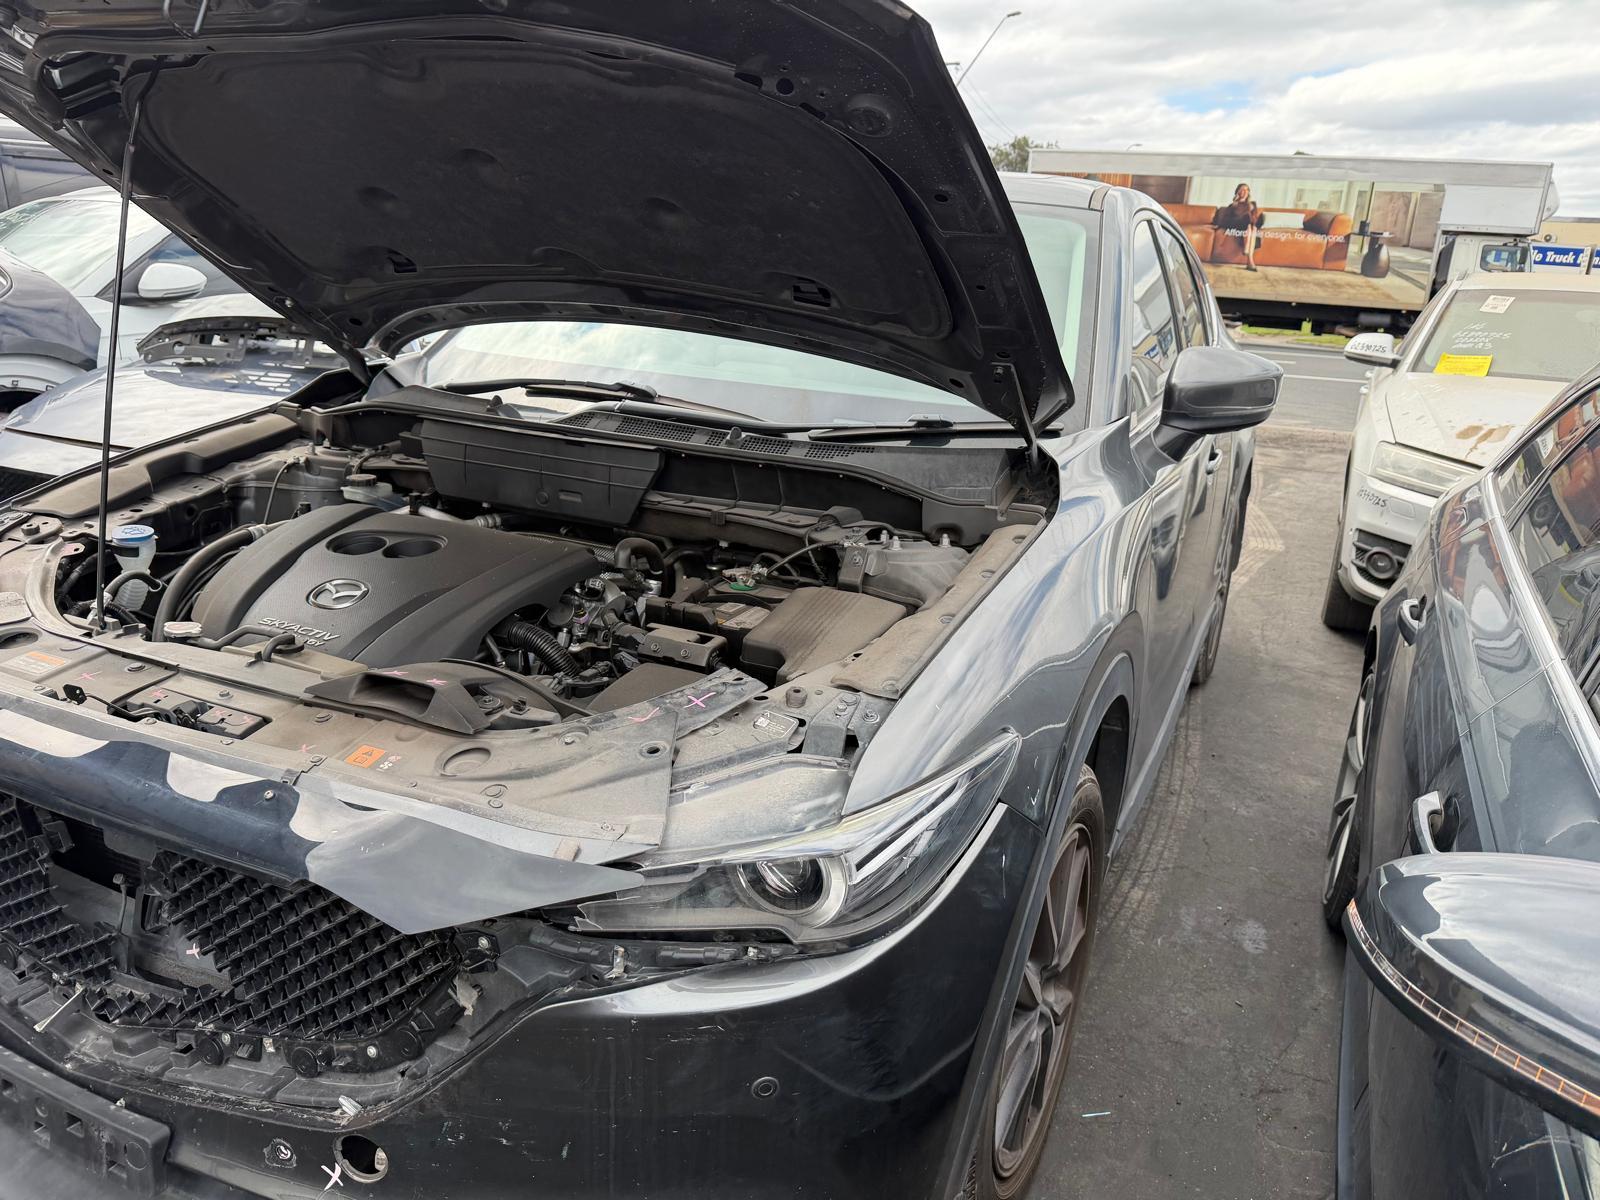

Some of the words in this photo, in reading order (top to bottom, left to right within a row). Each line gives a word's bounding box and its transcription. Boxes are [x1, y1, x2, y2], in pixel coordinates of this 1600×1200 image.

[1294, 231, 1306, 240] for
[1546, 251, 1575, 263] Truck
[258, 617, 341, 641] SKYACTIV
